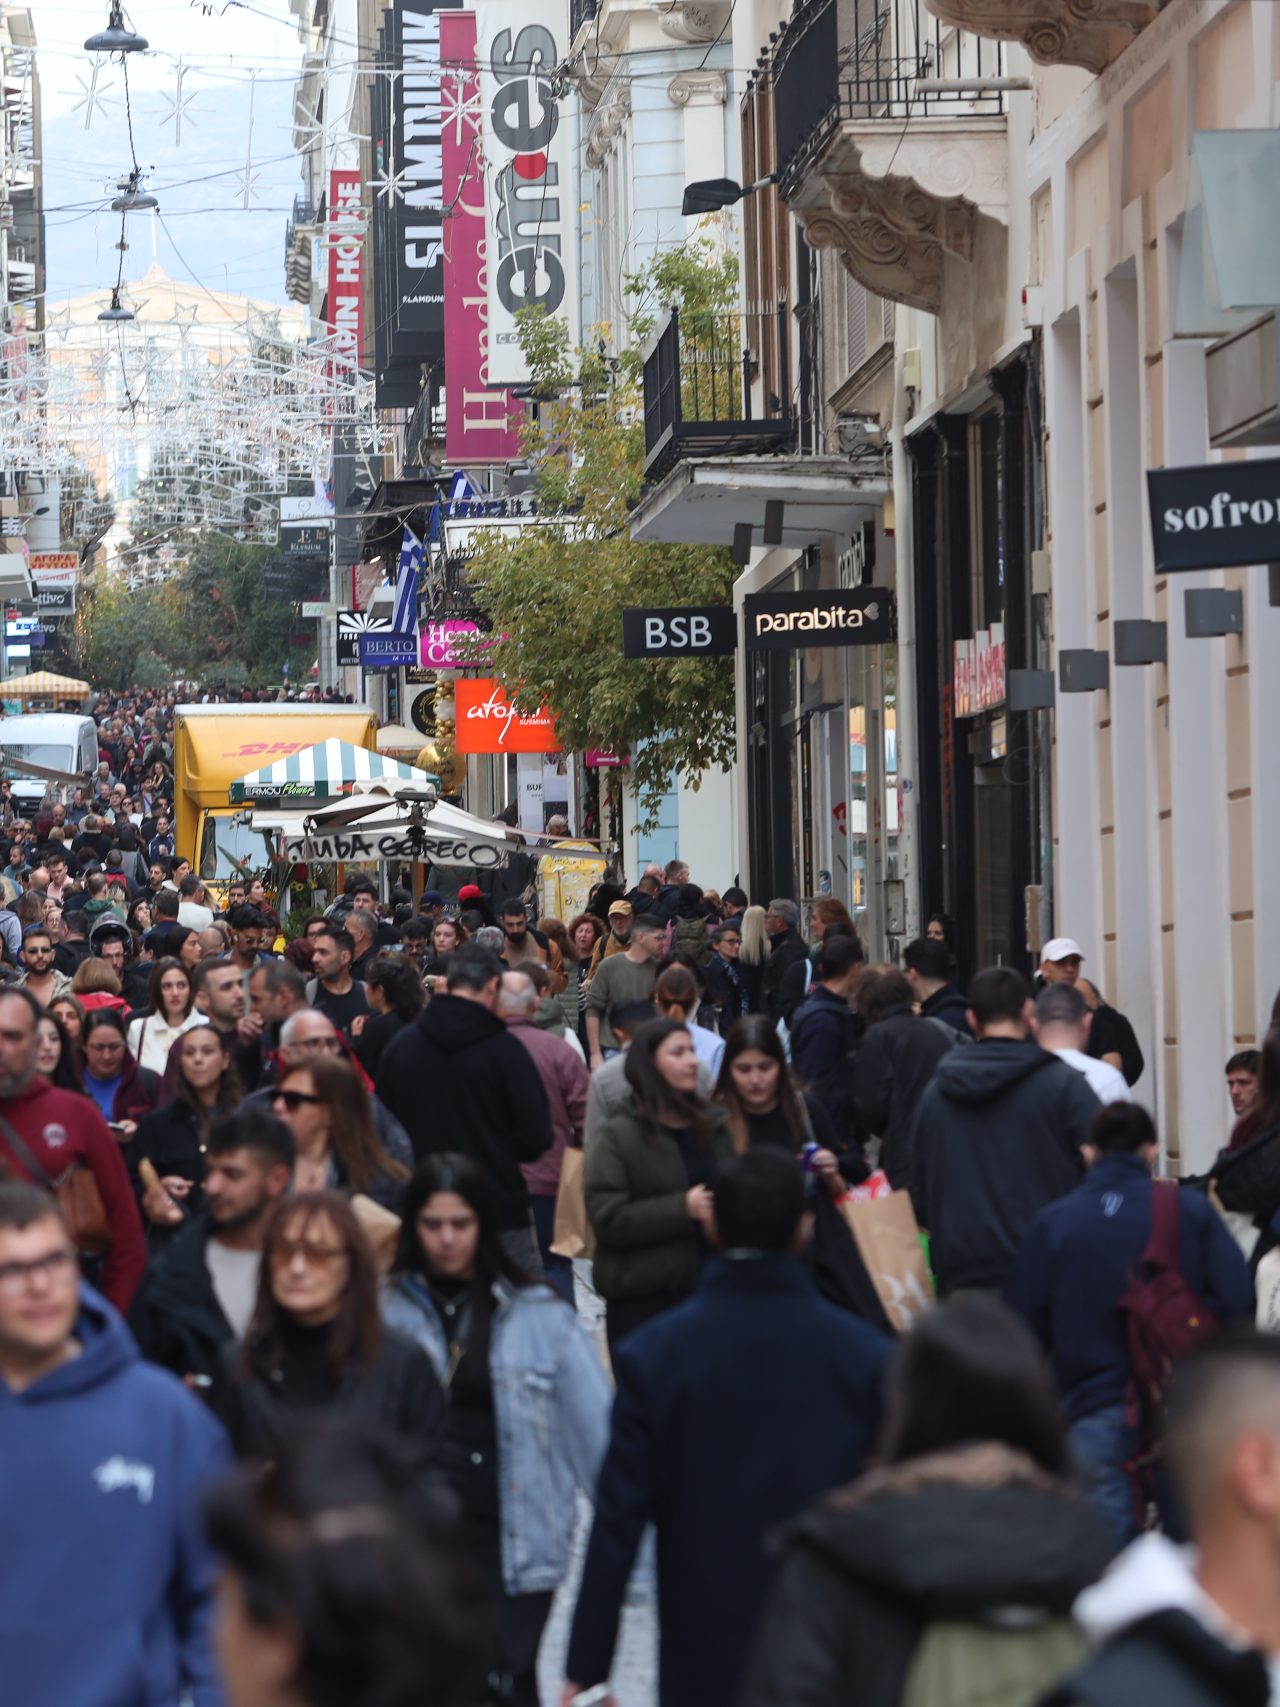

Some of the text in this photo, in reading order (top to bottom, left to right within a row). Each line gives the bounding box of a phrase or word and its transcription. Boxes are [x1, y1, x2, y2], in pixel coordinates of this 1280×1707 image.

[335, 181, 360, 283] HOUSE
[34, 553, 71, 562] ΑΓΟΡΑ
[33, 592, 65, 605] ttivo
[755, 604, 863, 636] parabita
[339, 633, 358, 641] FUNK
[645, 616, 713, 649] BSB
[366, 640, 414, 652] BERTO
[467, 686, 541, 745] ato
[245, 783, 315, 797] ERMOU Flower
